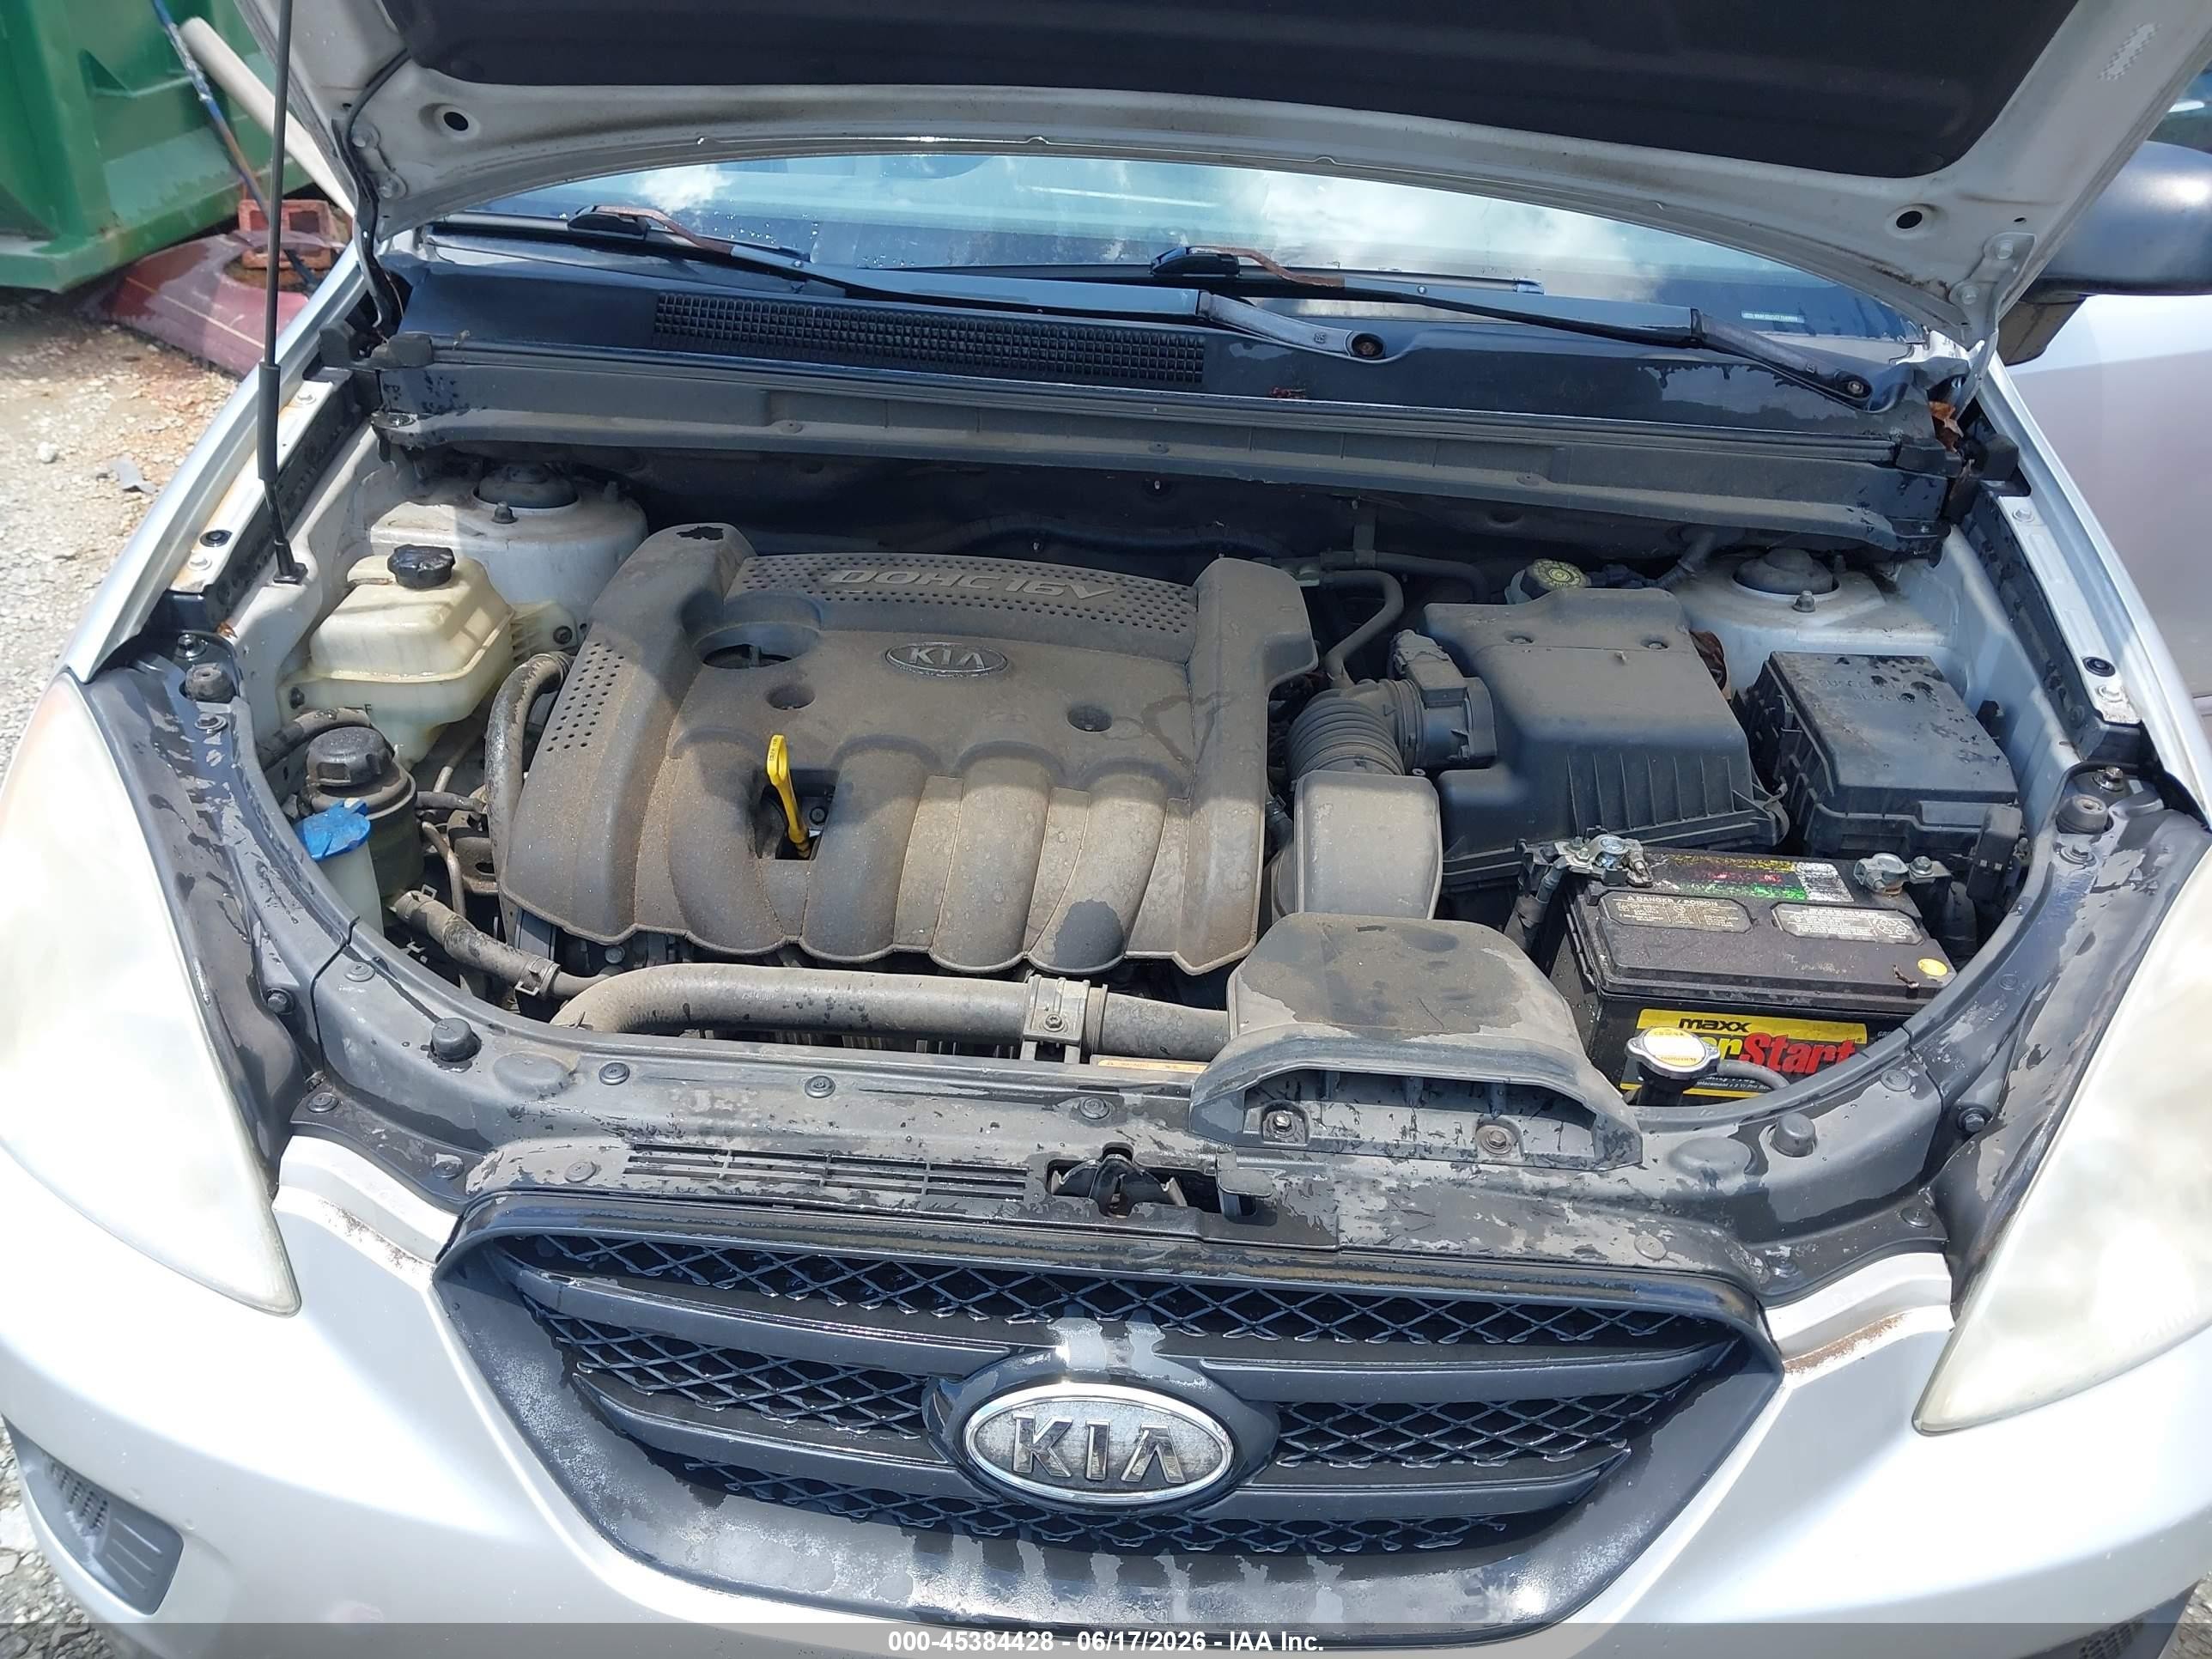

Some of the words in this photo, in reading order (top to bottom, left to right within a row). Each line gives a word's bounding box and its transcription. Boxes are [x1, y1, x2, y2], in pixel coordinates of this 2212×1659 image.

[908, 647, 986, 669] KIA
[363, 703, 373, 714] F
[1636, 896, 1674, 904] DANGER
[1683, 899, 1719, 908] POISON
[1677, 1018, 1753, 1033] maxx
[1012, 1413, 1187, 1485] KIA
